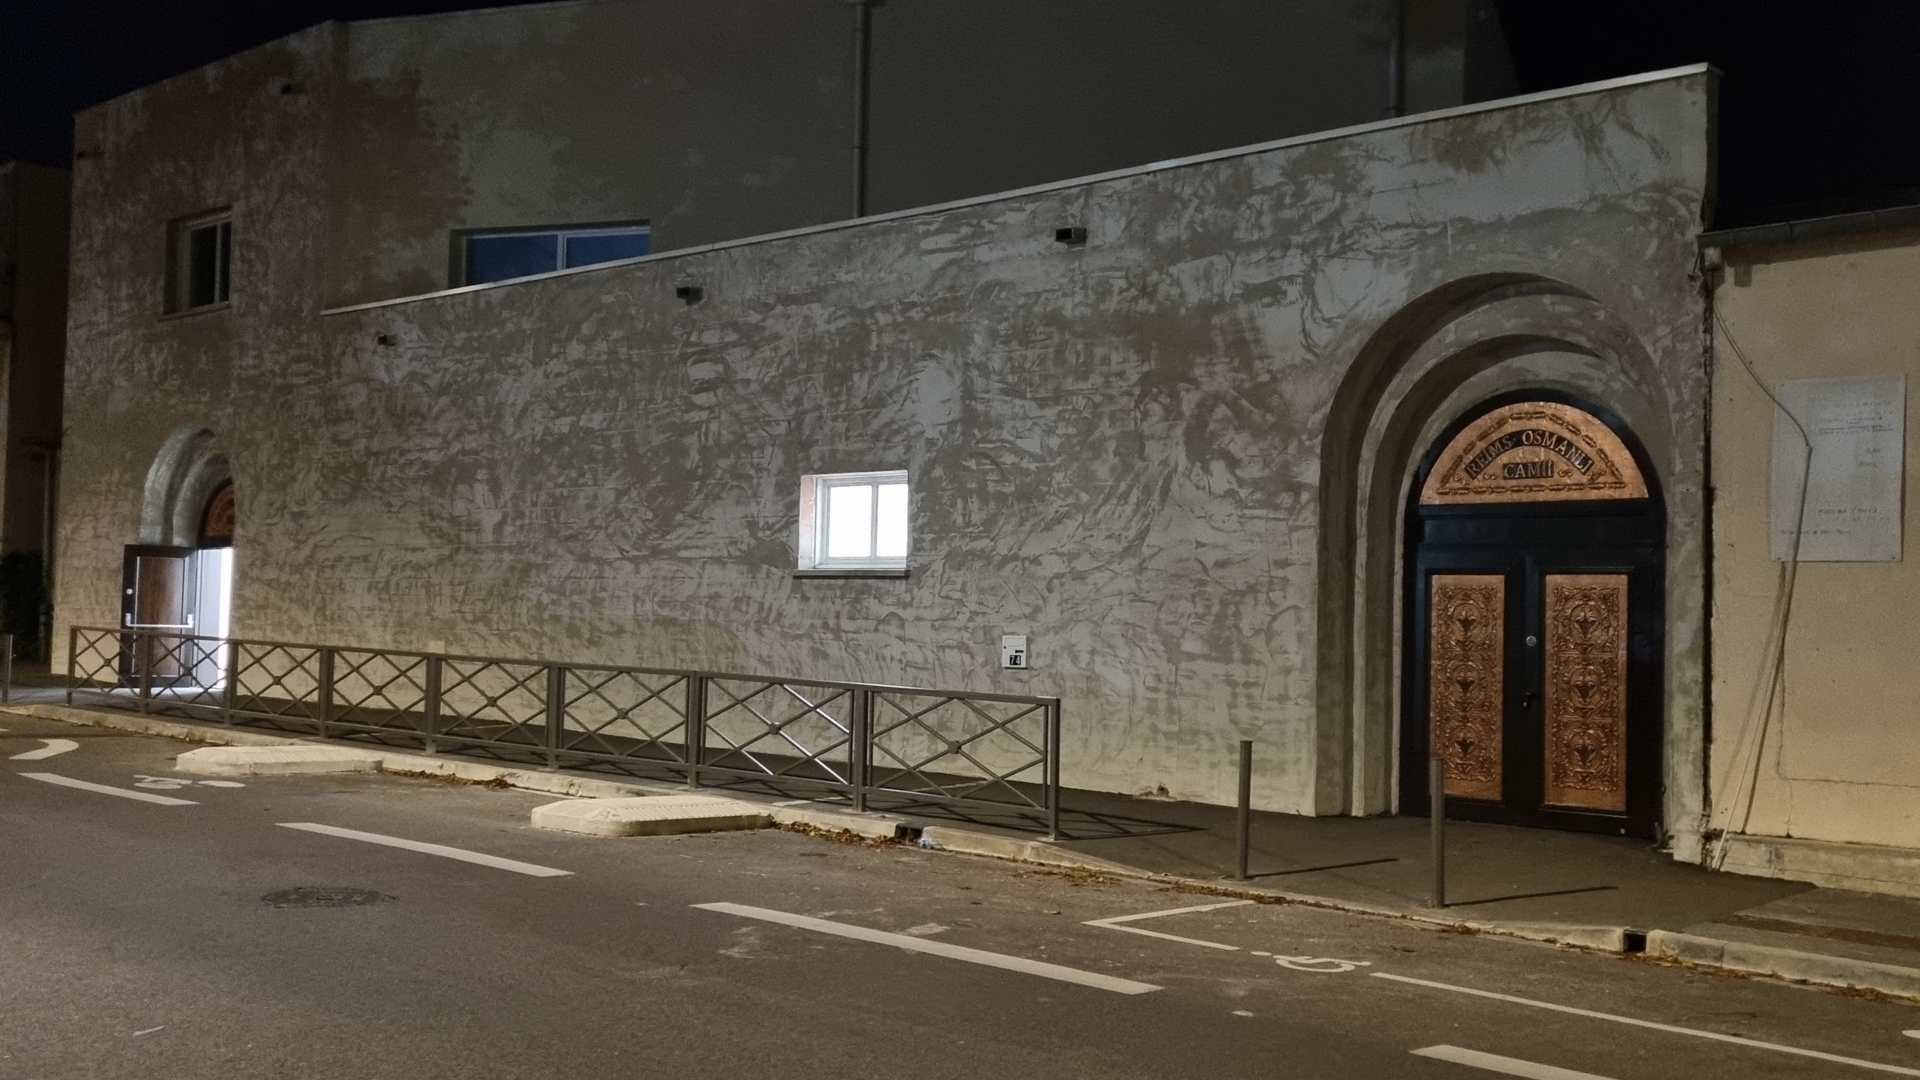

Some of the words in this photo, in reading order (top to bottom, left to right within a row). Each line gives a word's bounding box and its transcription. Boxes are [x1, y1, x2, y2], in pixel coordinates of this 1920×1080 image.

[1466, 435, 1513, 478] REIMS
[1521, 430, 1593, 473] OSMANLI
[1010, 655, 1021, 665] 74
